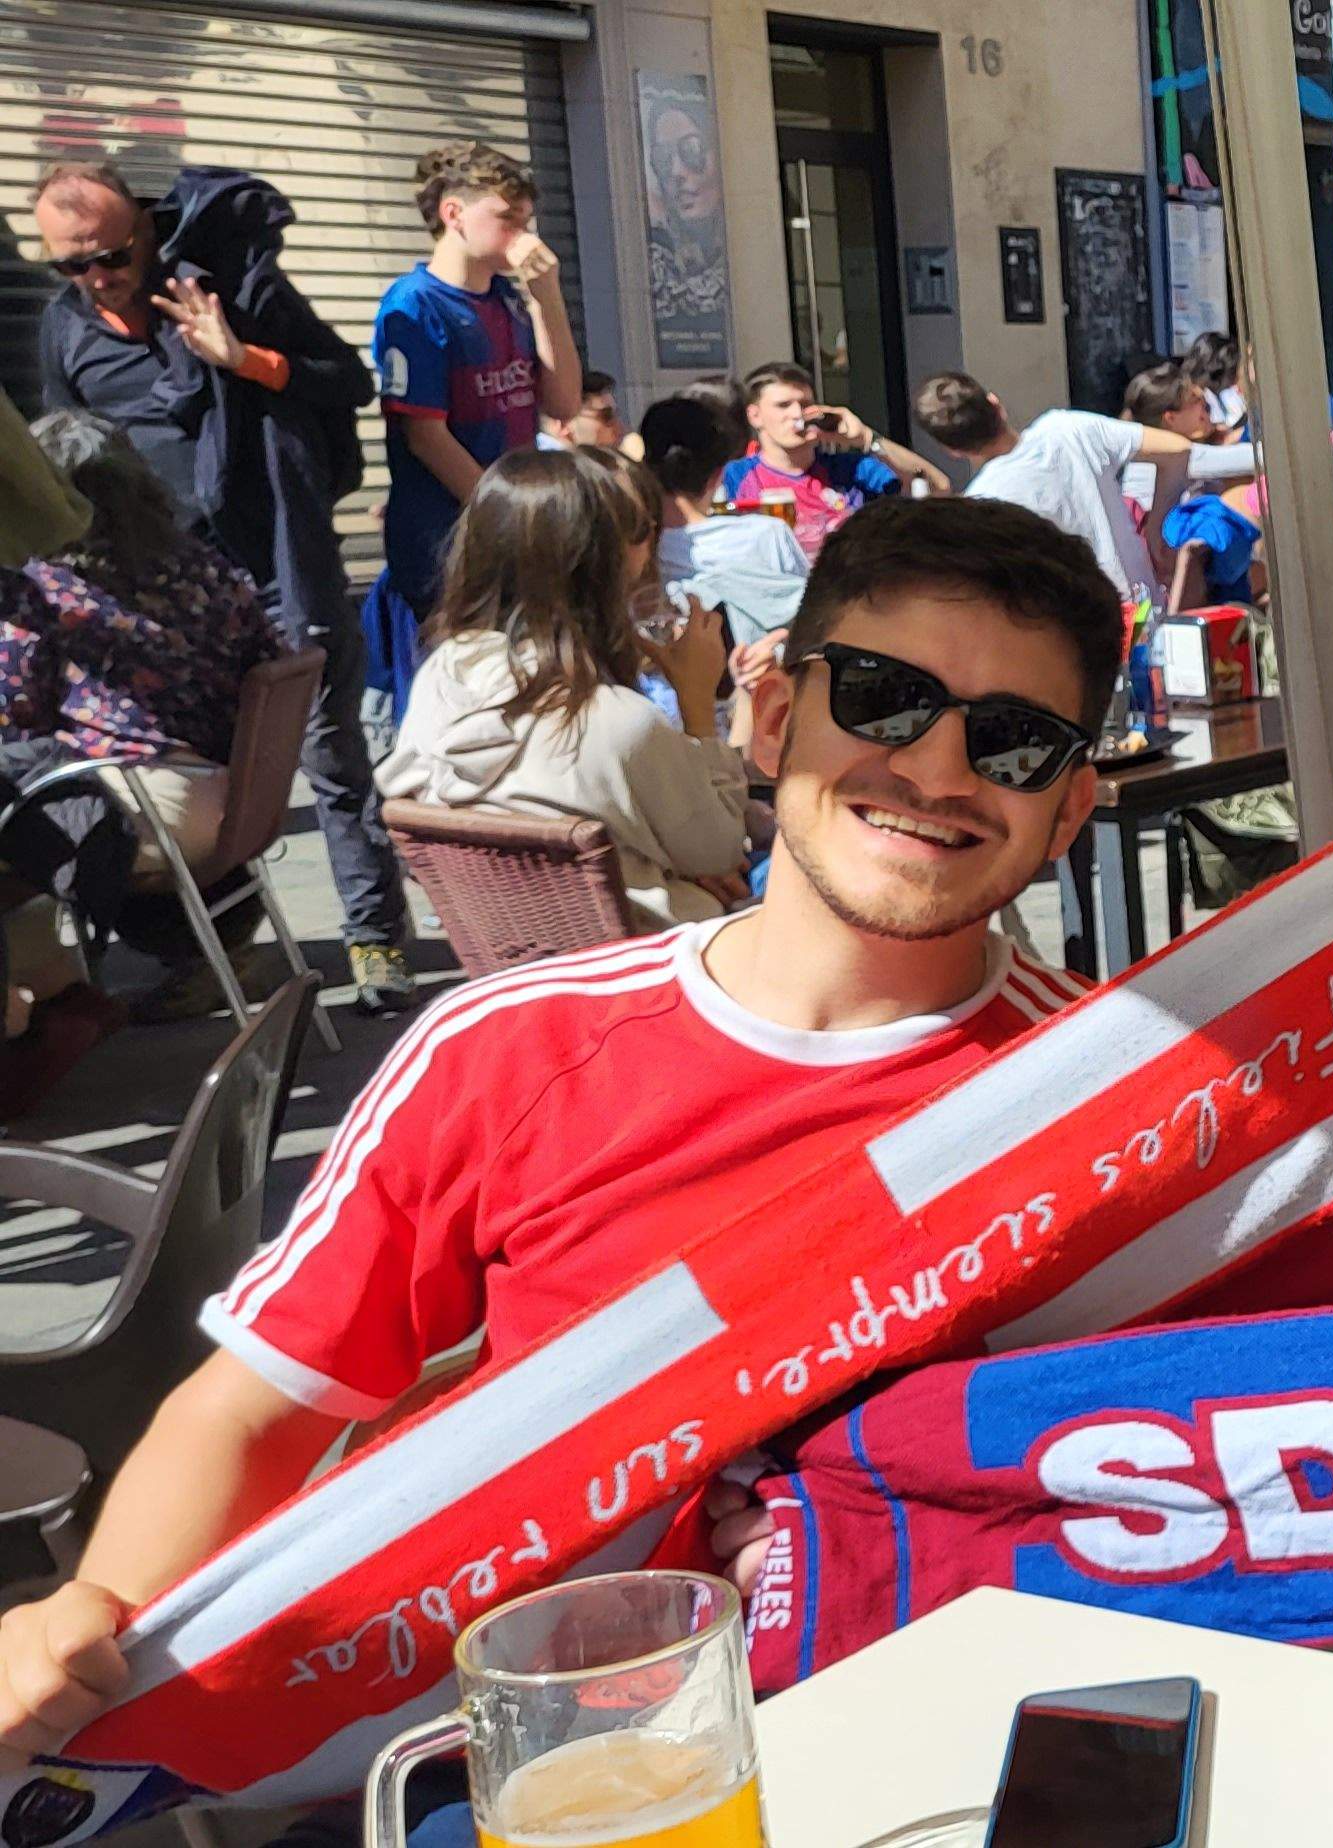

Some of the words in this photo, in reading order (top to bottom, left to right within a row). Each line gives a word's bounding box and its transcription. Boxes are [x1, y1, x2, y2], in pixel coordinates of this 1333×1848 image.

[959, 35, 1004, 78] 16
[586, 1419, 704, 1522] sin
[285, 1519, 550, 1688] reblar
